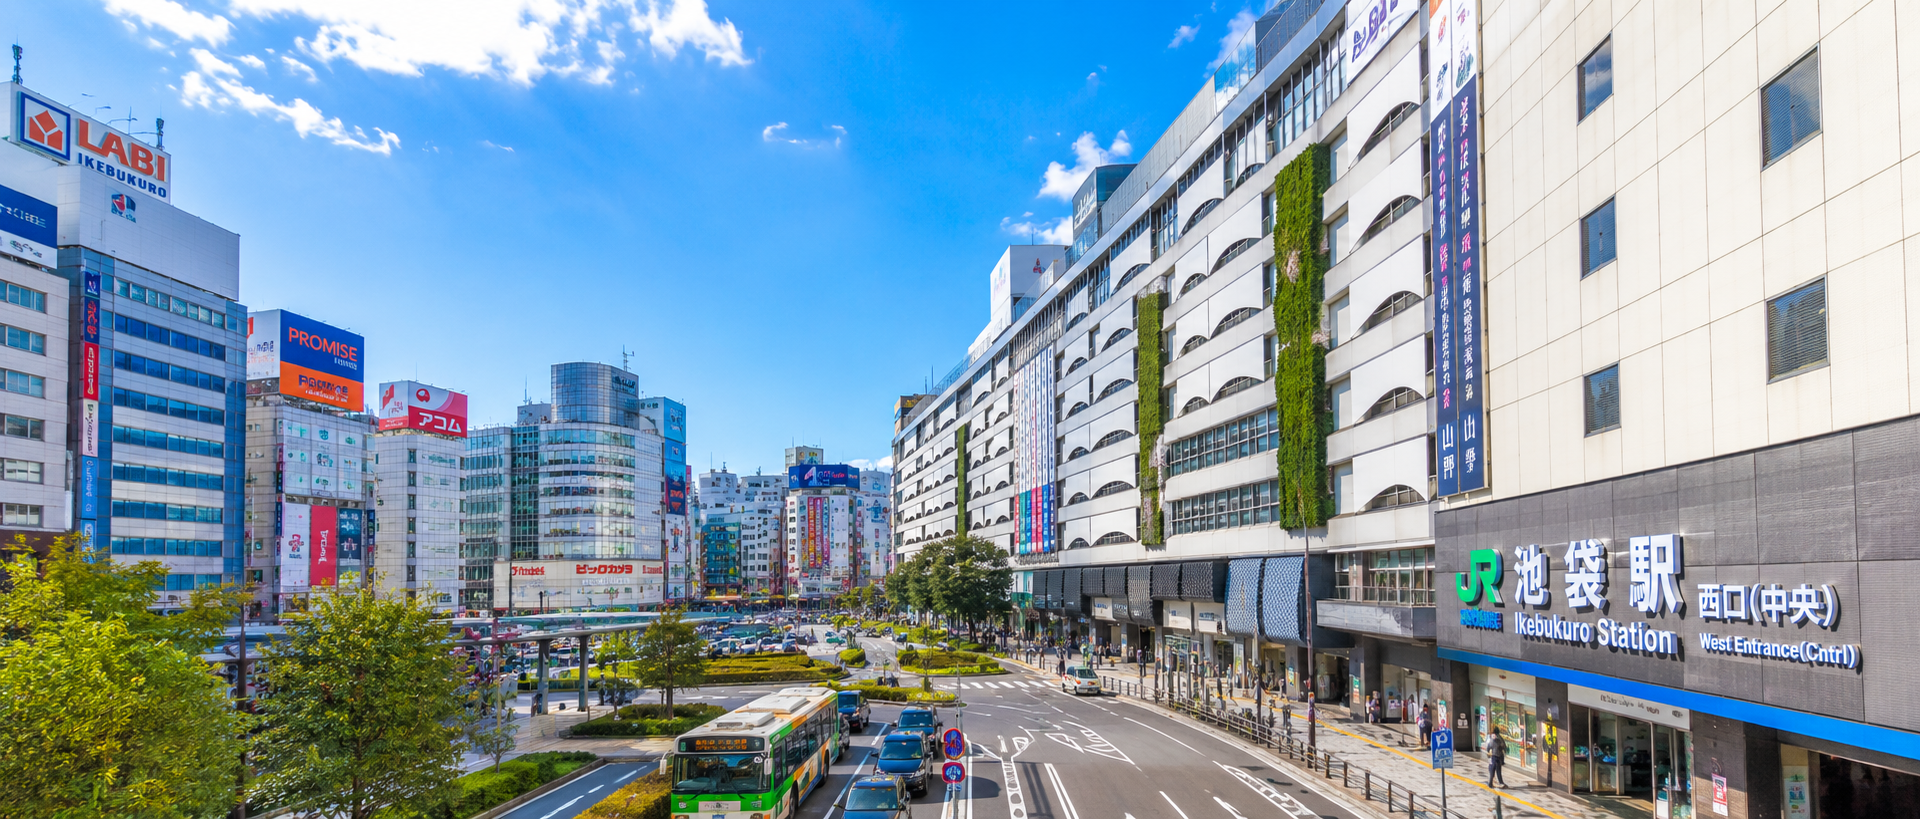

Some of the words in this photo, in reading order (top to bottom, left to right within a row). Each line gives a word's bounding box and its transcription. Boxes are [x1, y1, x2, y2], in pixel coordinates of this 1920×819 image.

[77, 117, 167, 183] LABI
[77, 151, 168, 199] IKEBUKURO
[288, 326, 358, 363] PROMISE
[418, 411, 462, 434] アコム
[1455, 548, 1504, 604] JR
[1513, 533, 1685, 614] 池袋駅
[1697, 583, 1839, 628] 西口(中央)
[1514, 611, 1594, 644] Ikebukuro
[1597, 617, 1678, 655] Station
[1698, 632, 1733, 652] West
